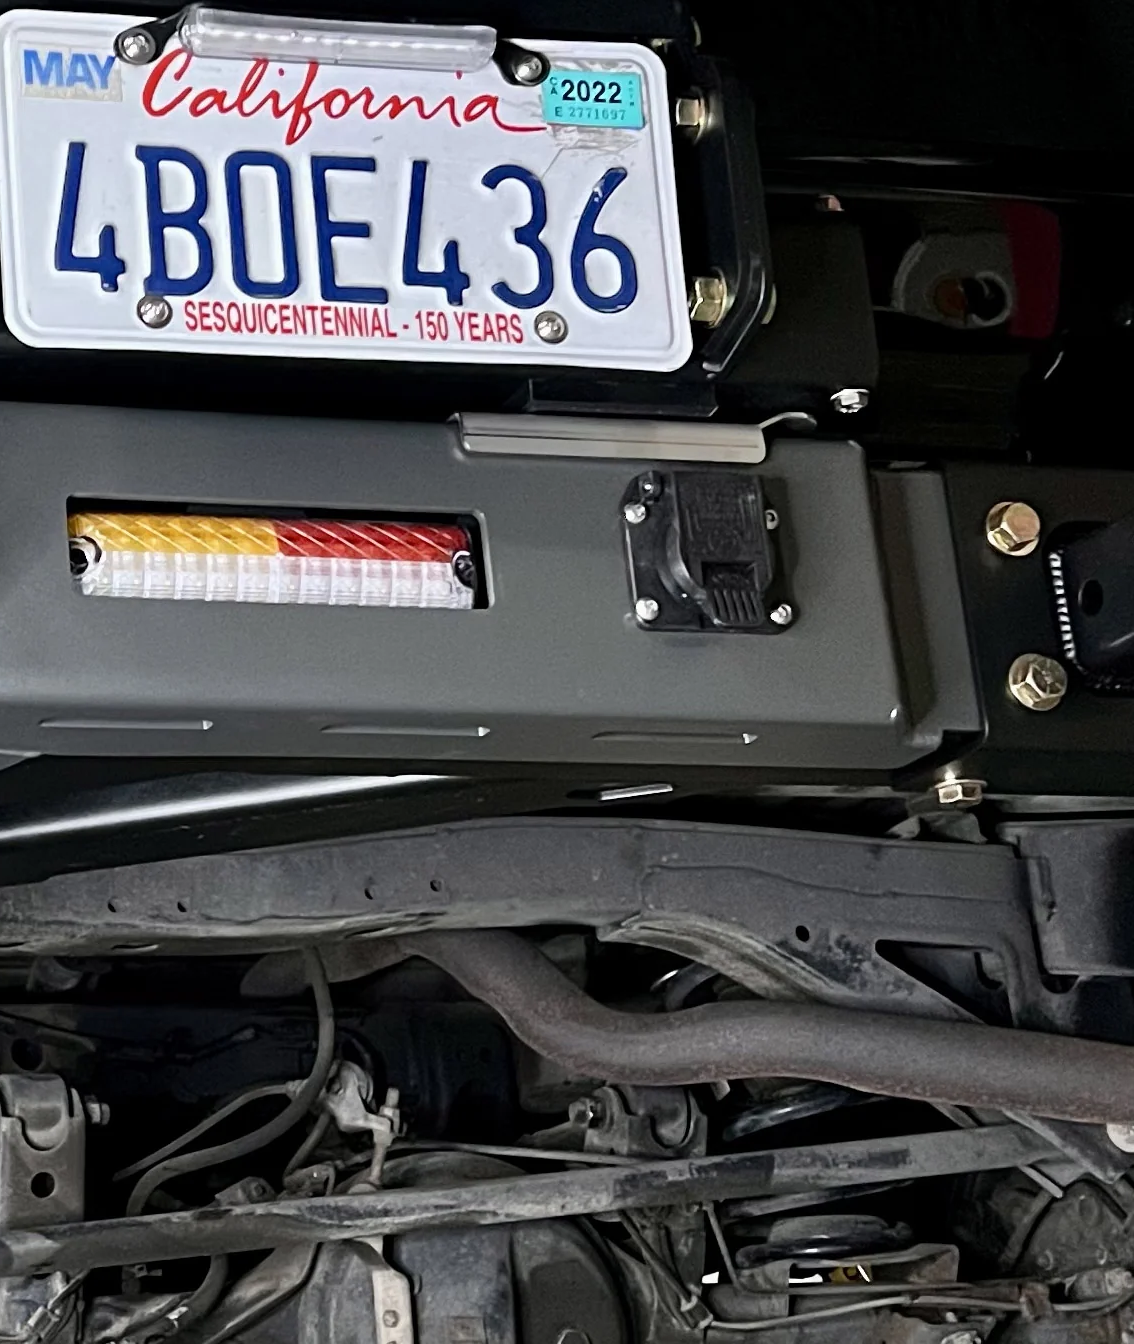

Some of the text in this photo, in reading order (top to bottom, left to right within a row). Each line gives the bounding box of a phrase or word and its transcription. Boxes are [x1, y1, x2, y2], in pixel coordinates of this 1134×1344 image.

[23, 49, 116, 89] MAY
[142, 47, 547, 145] California
[561, 79, 622, 103] 2022
[184, 300, 397, 338] SESQUICENTENNIAL
[415, 311, 449, 341] 150
[454, 312, 524, 344] YEARS
